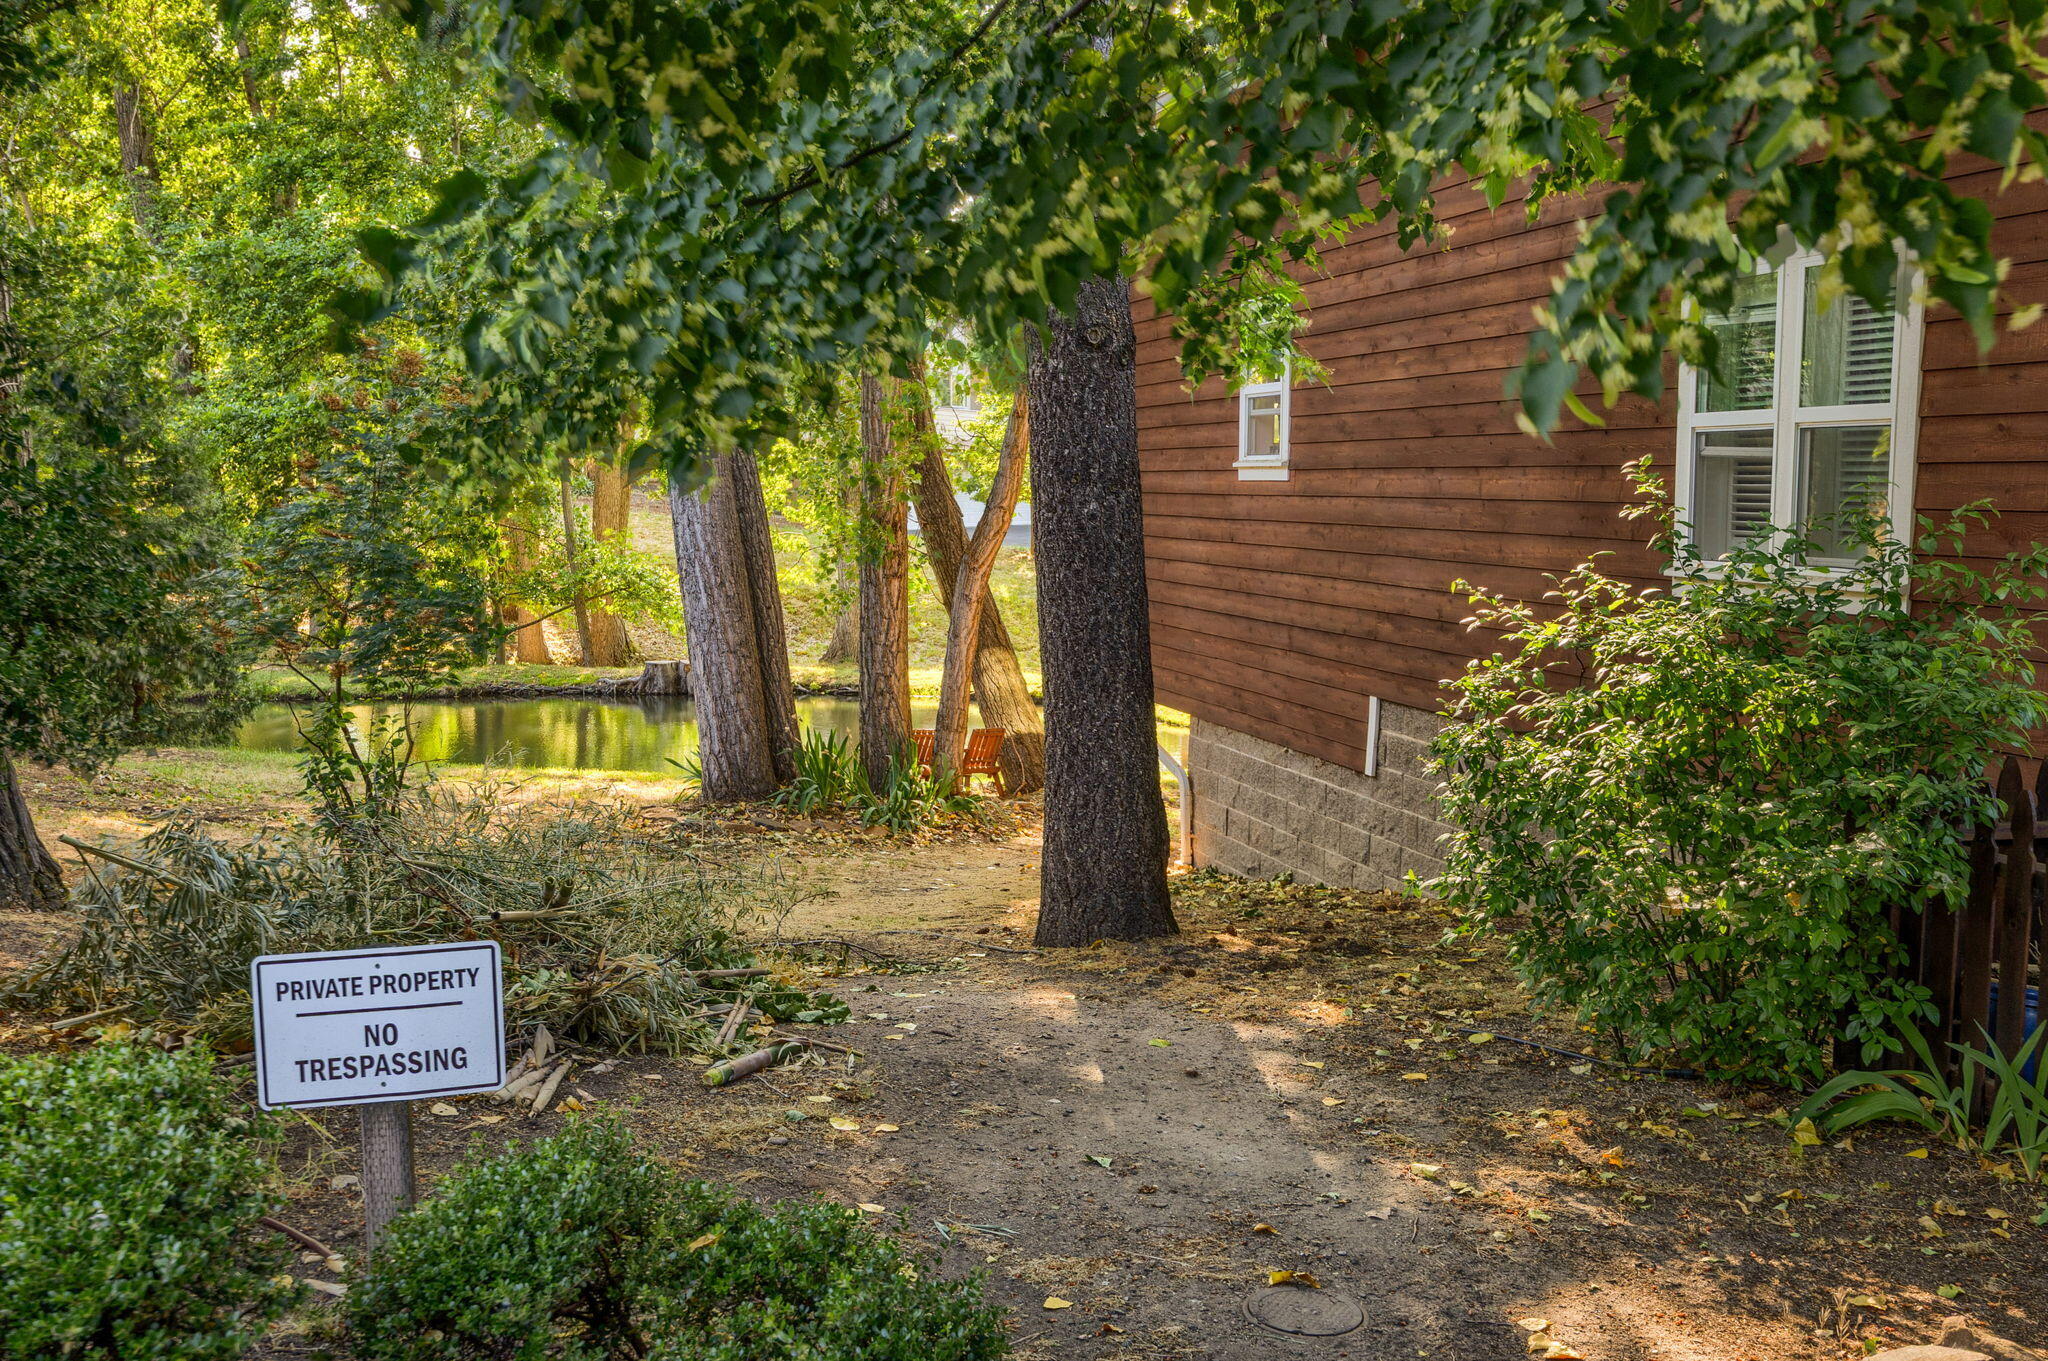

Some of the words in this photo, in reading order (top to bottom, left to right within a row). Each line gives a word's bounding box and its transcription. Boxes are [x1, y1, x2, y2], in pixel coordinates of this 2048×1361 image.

[275, 976, 363, 1002] PRIVATE
[369, 967, 480, 995] PROPERTY
[363, 1022, 399, 1048] NO
[294, 1046, 468, 1083] TRESPASSING
